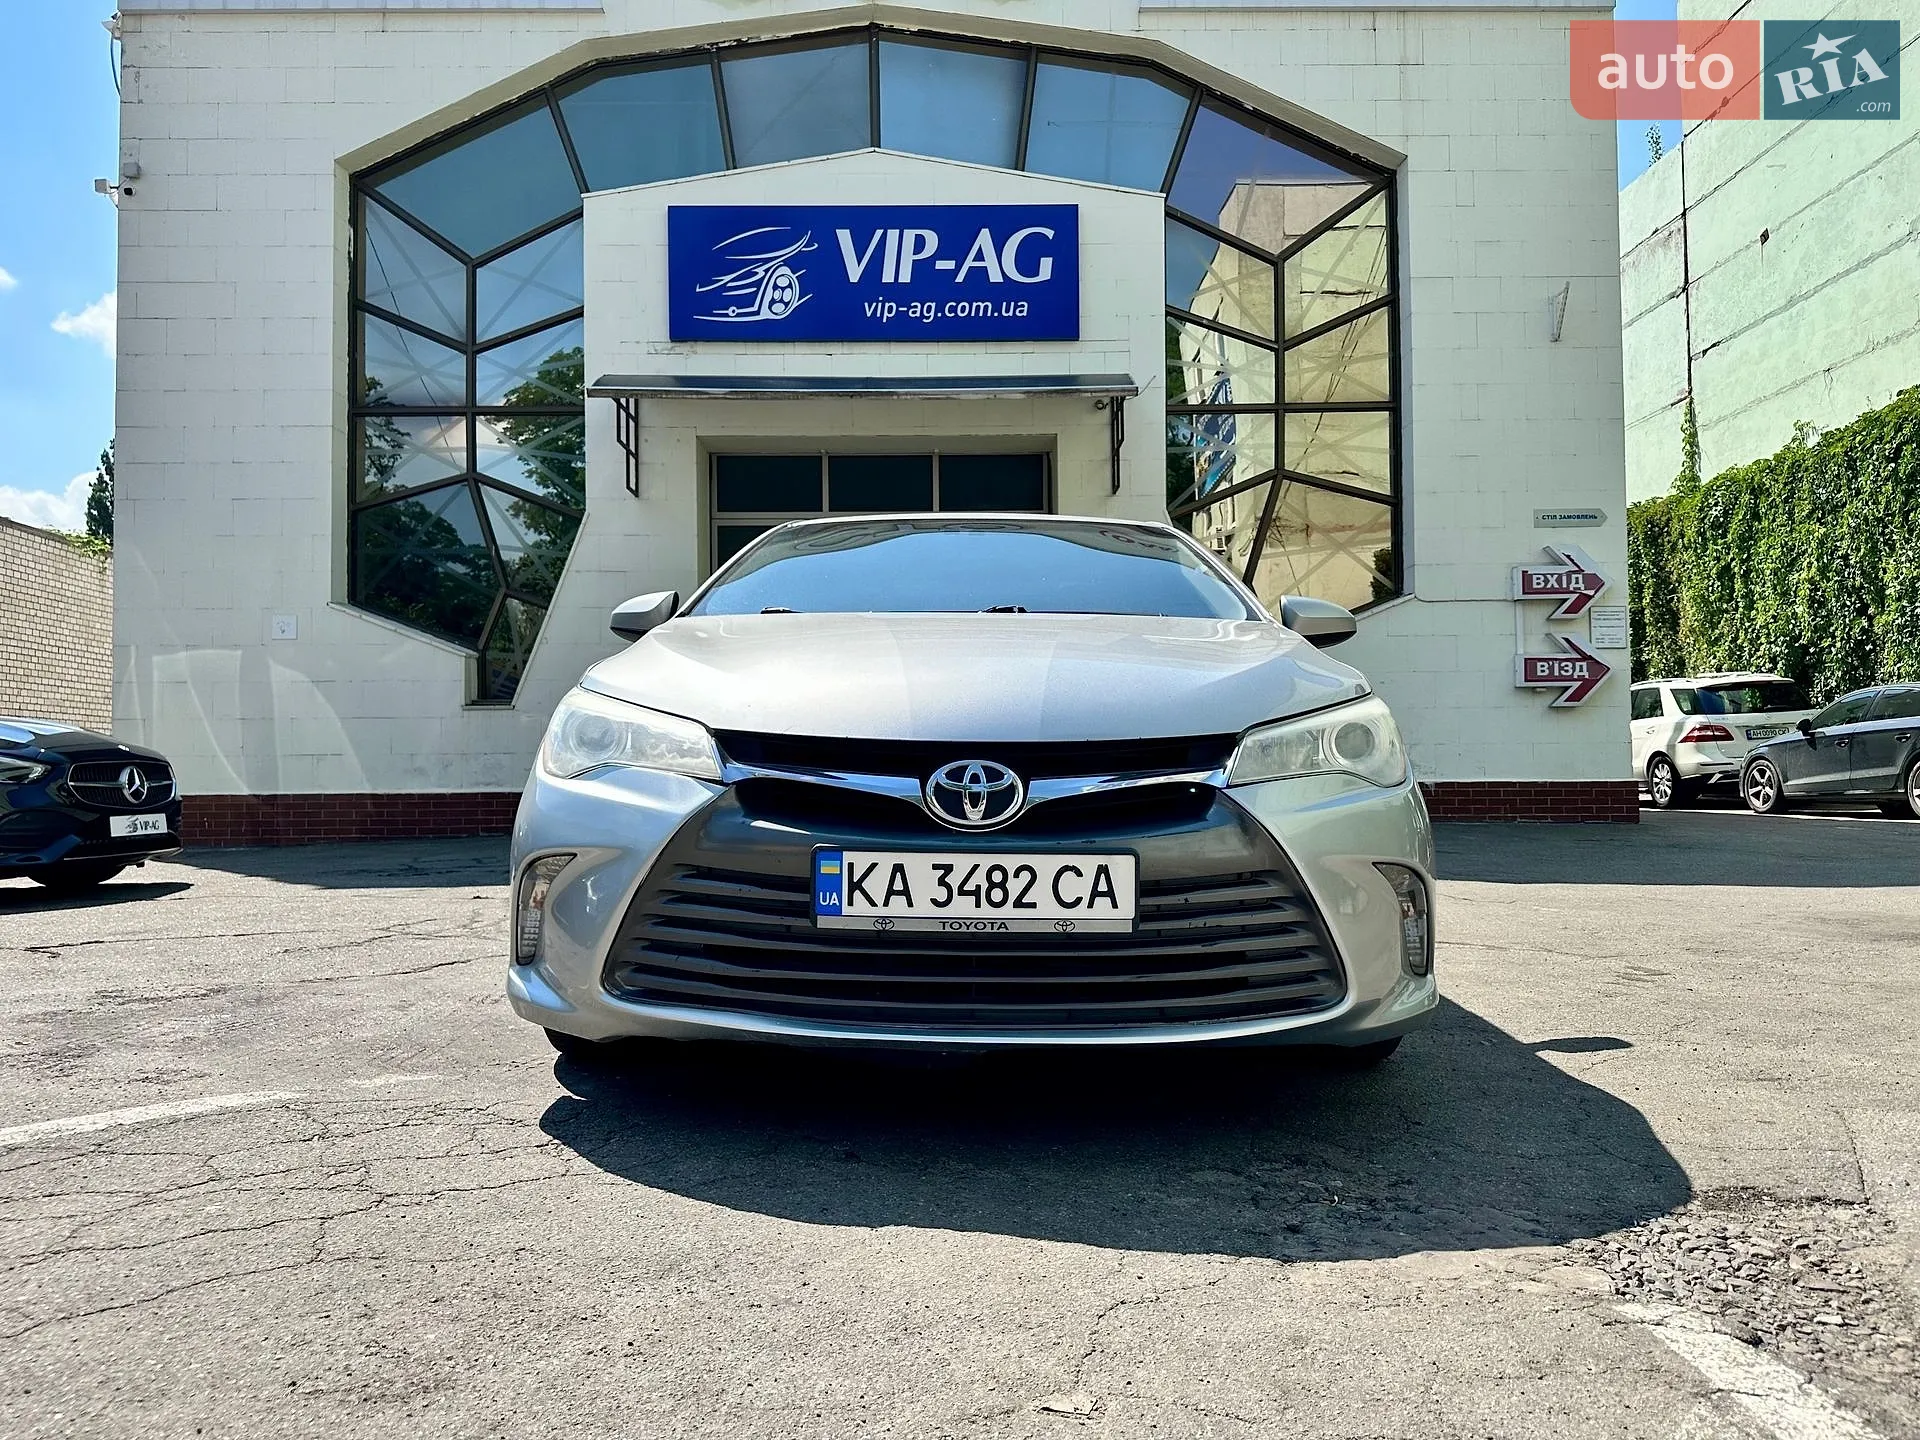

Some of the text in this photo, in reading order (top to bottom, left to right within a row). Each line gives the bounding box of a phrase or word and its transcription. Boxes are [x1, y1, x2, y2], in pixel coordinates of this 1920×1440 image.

[835, 227, 1055, 283] VIP-AG
[864, 296, 1029, 323] vip-ag.com.ua
[139, 820, 159, 831] VIP-AG
[847, 862, 1119, 909] KA 3482 CA
[819, 891, 839, 906] UA
[938, 921, 1010, 931] TOYOTA
